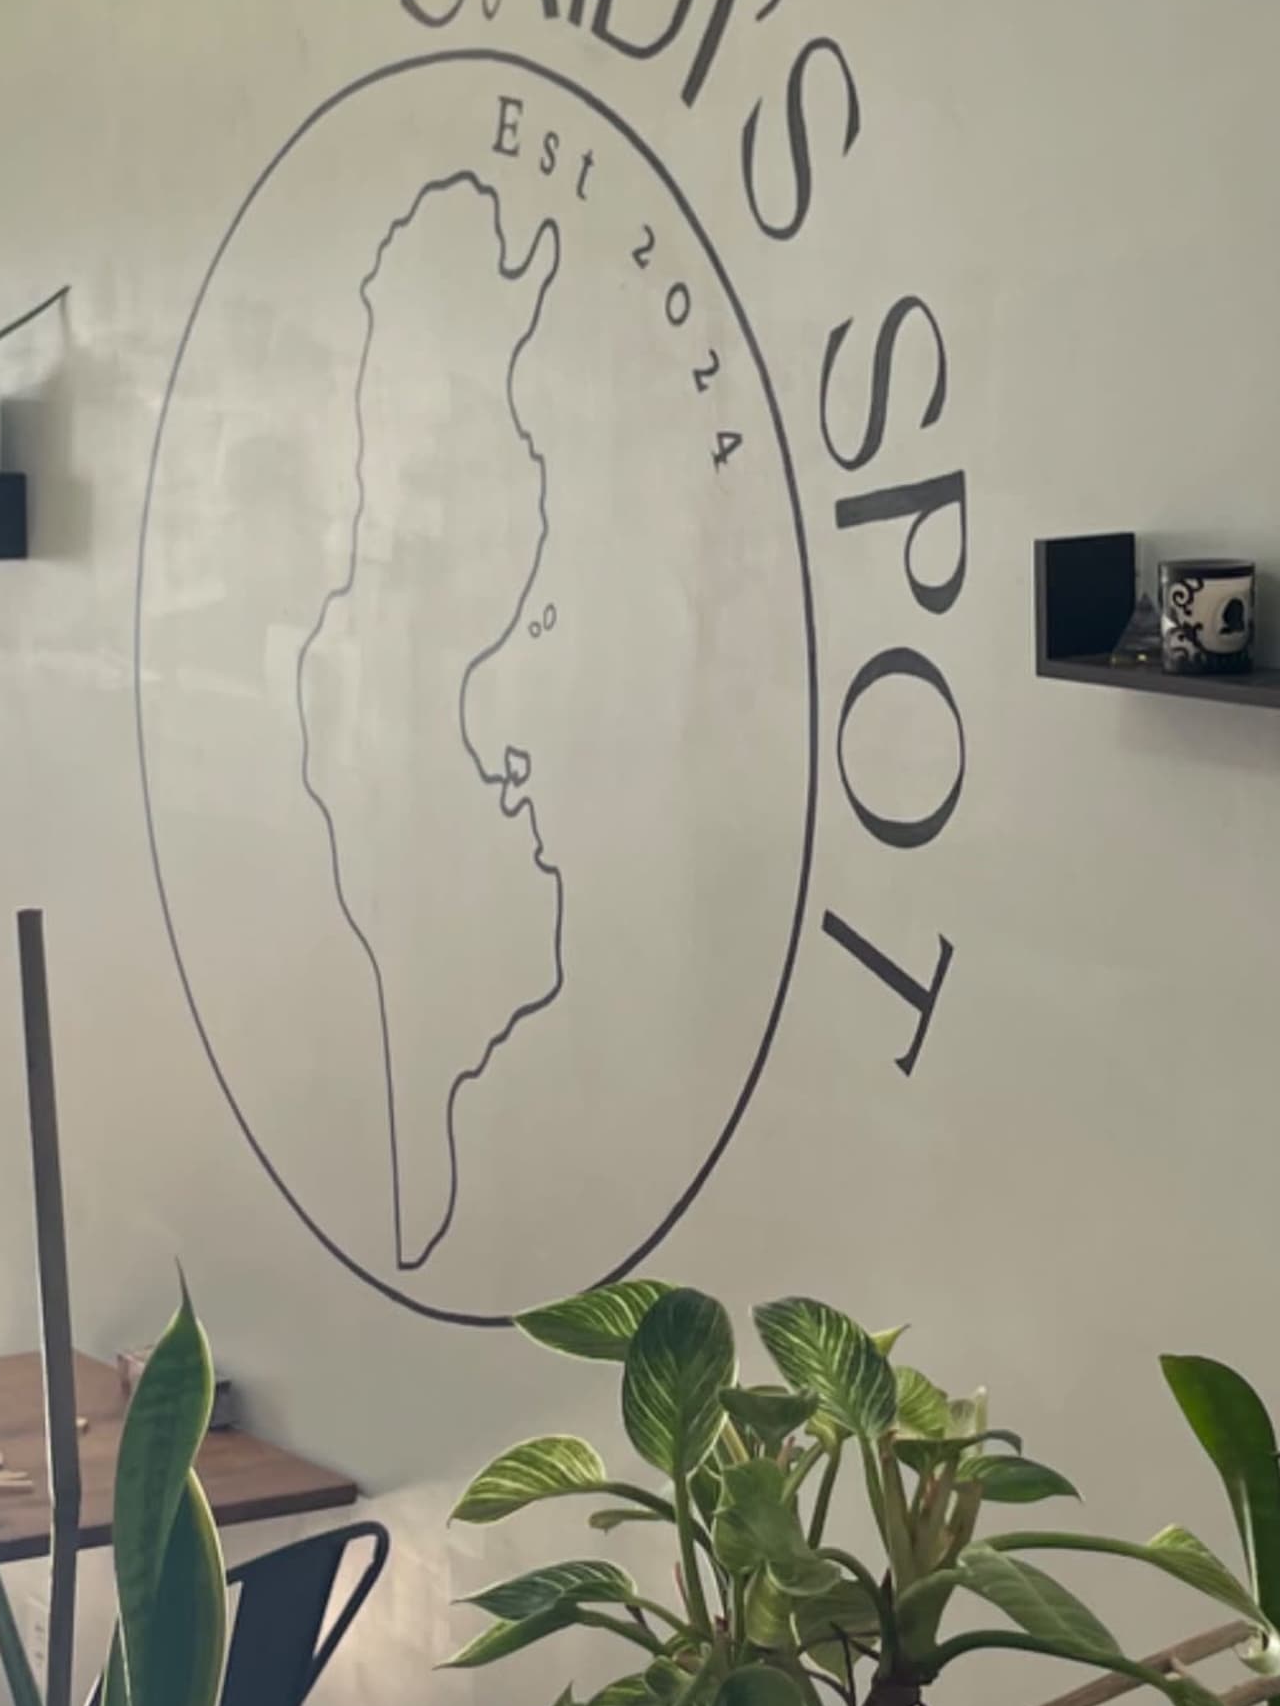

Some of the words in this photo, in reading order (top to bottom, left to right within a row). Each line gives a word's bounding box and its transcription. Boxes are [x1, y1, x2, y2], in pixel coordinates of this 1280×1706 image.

[492, 95, 594, 201] Est
[631, 223, 743, 474] 2024
[819, 294, 967, 1077] SPOT
